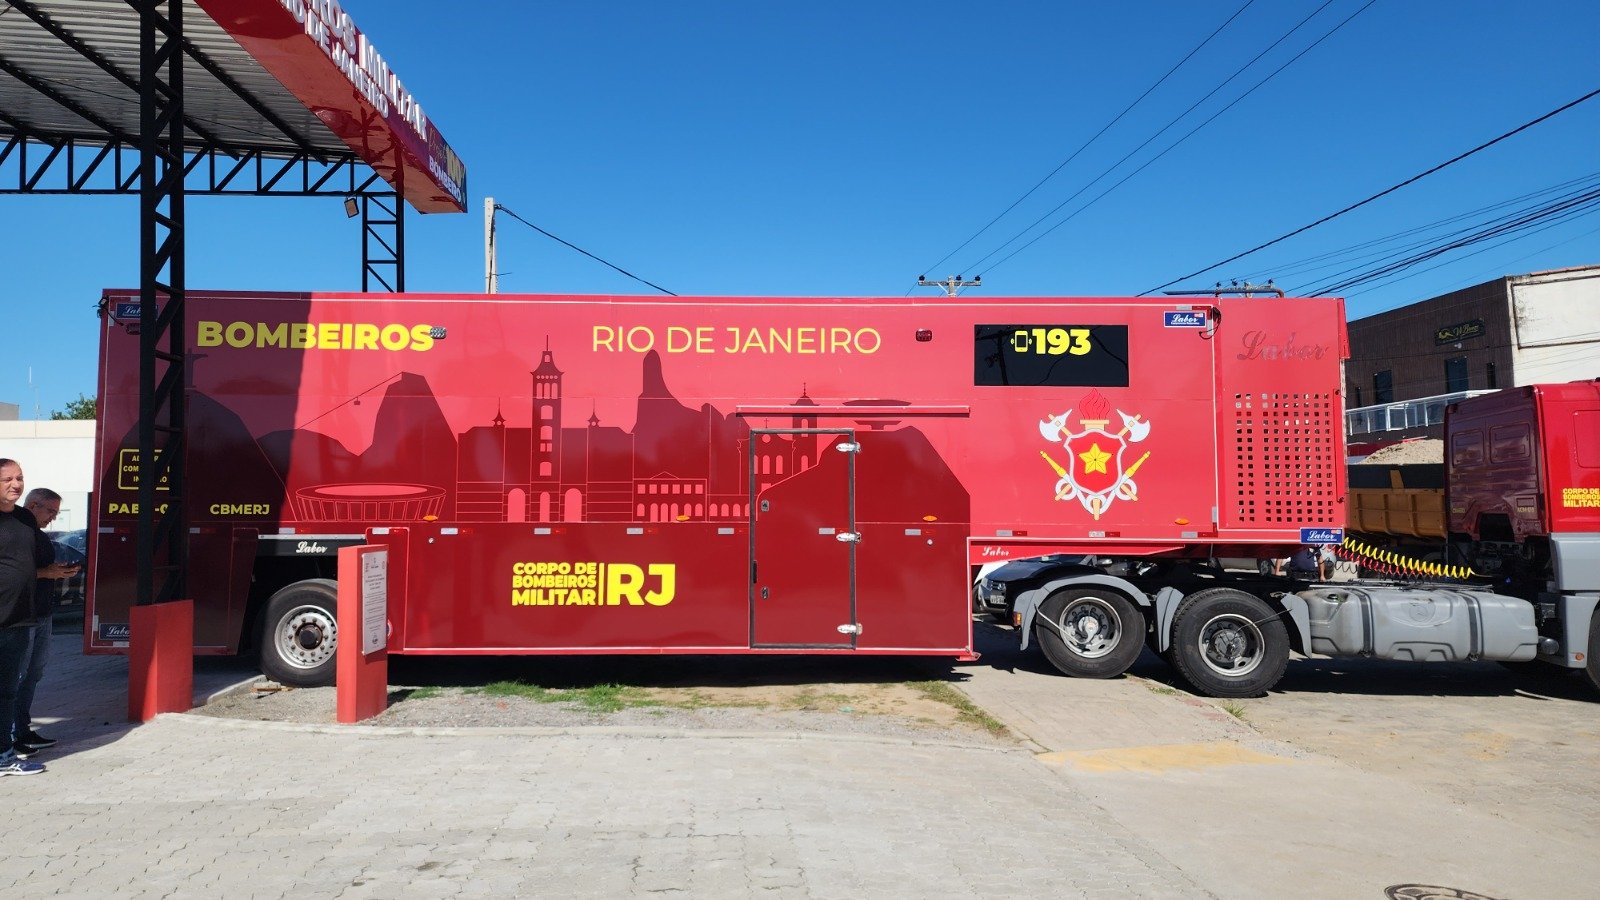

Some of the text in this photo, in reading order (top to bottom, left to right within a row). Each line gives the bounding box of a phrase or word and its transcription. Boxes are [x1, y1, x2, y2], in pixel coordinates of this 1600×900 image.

[305, 8, 331, 59] DE
[332, 42, 389, 119] JANEIRO
[358, 34, 428, 143] MILITAR
[197, 321, 434, 352] BOMBEIROS
[592, 325, 882, 355] RIO DE JANEIRO
[1032, 328, 1092, 356] 193
[210, 503, 271, 515] CBMERJ
[1563, 500, 1600, 508] MILITAR
[295, 540, 329, 554] Labor
[512, 562, 597, 575] CORPO DE
[512, 575, 597, 588] BOMBEIROS
[606, 563, 676, 607] RJ
[511, 589, 596, 606] MILITAR
